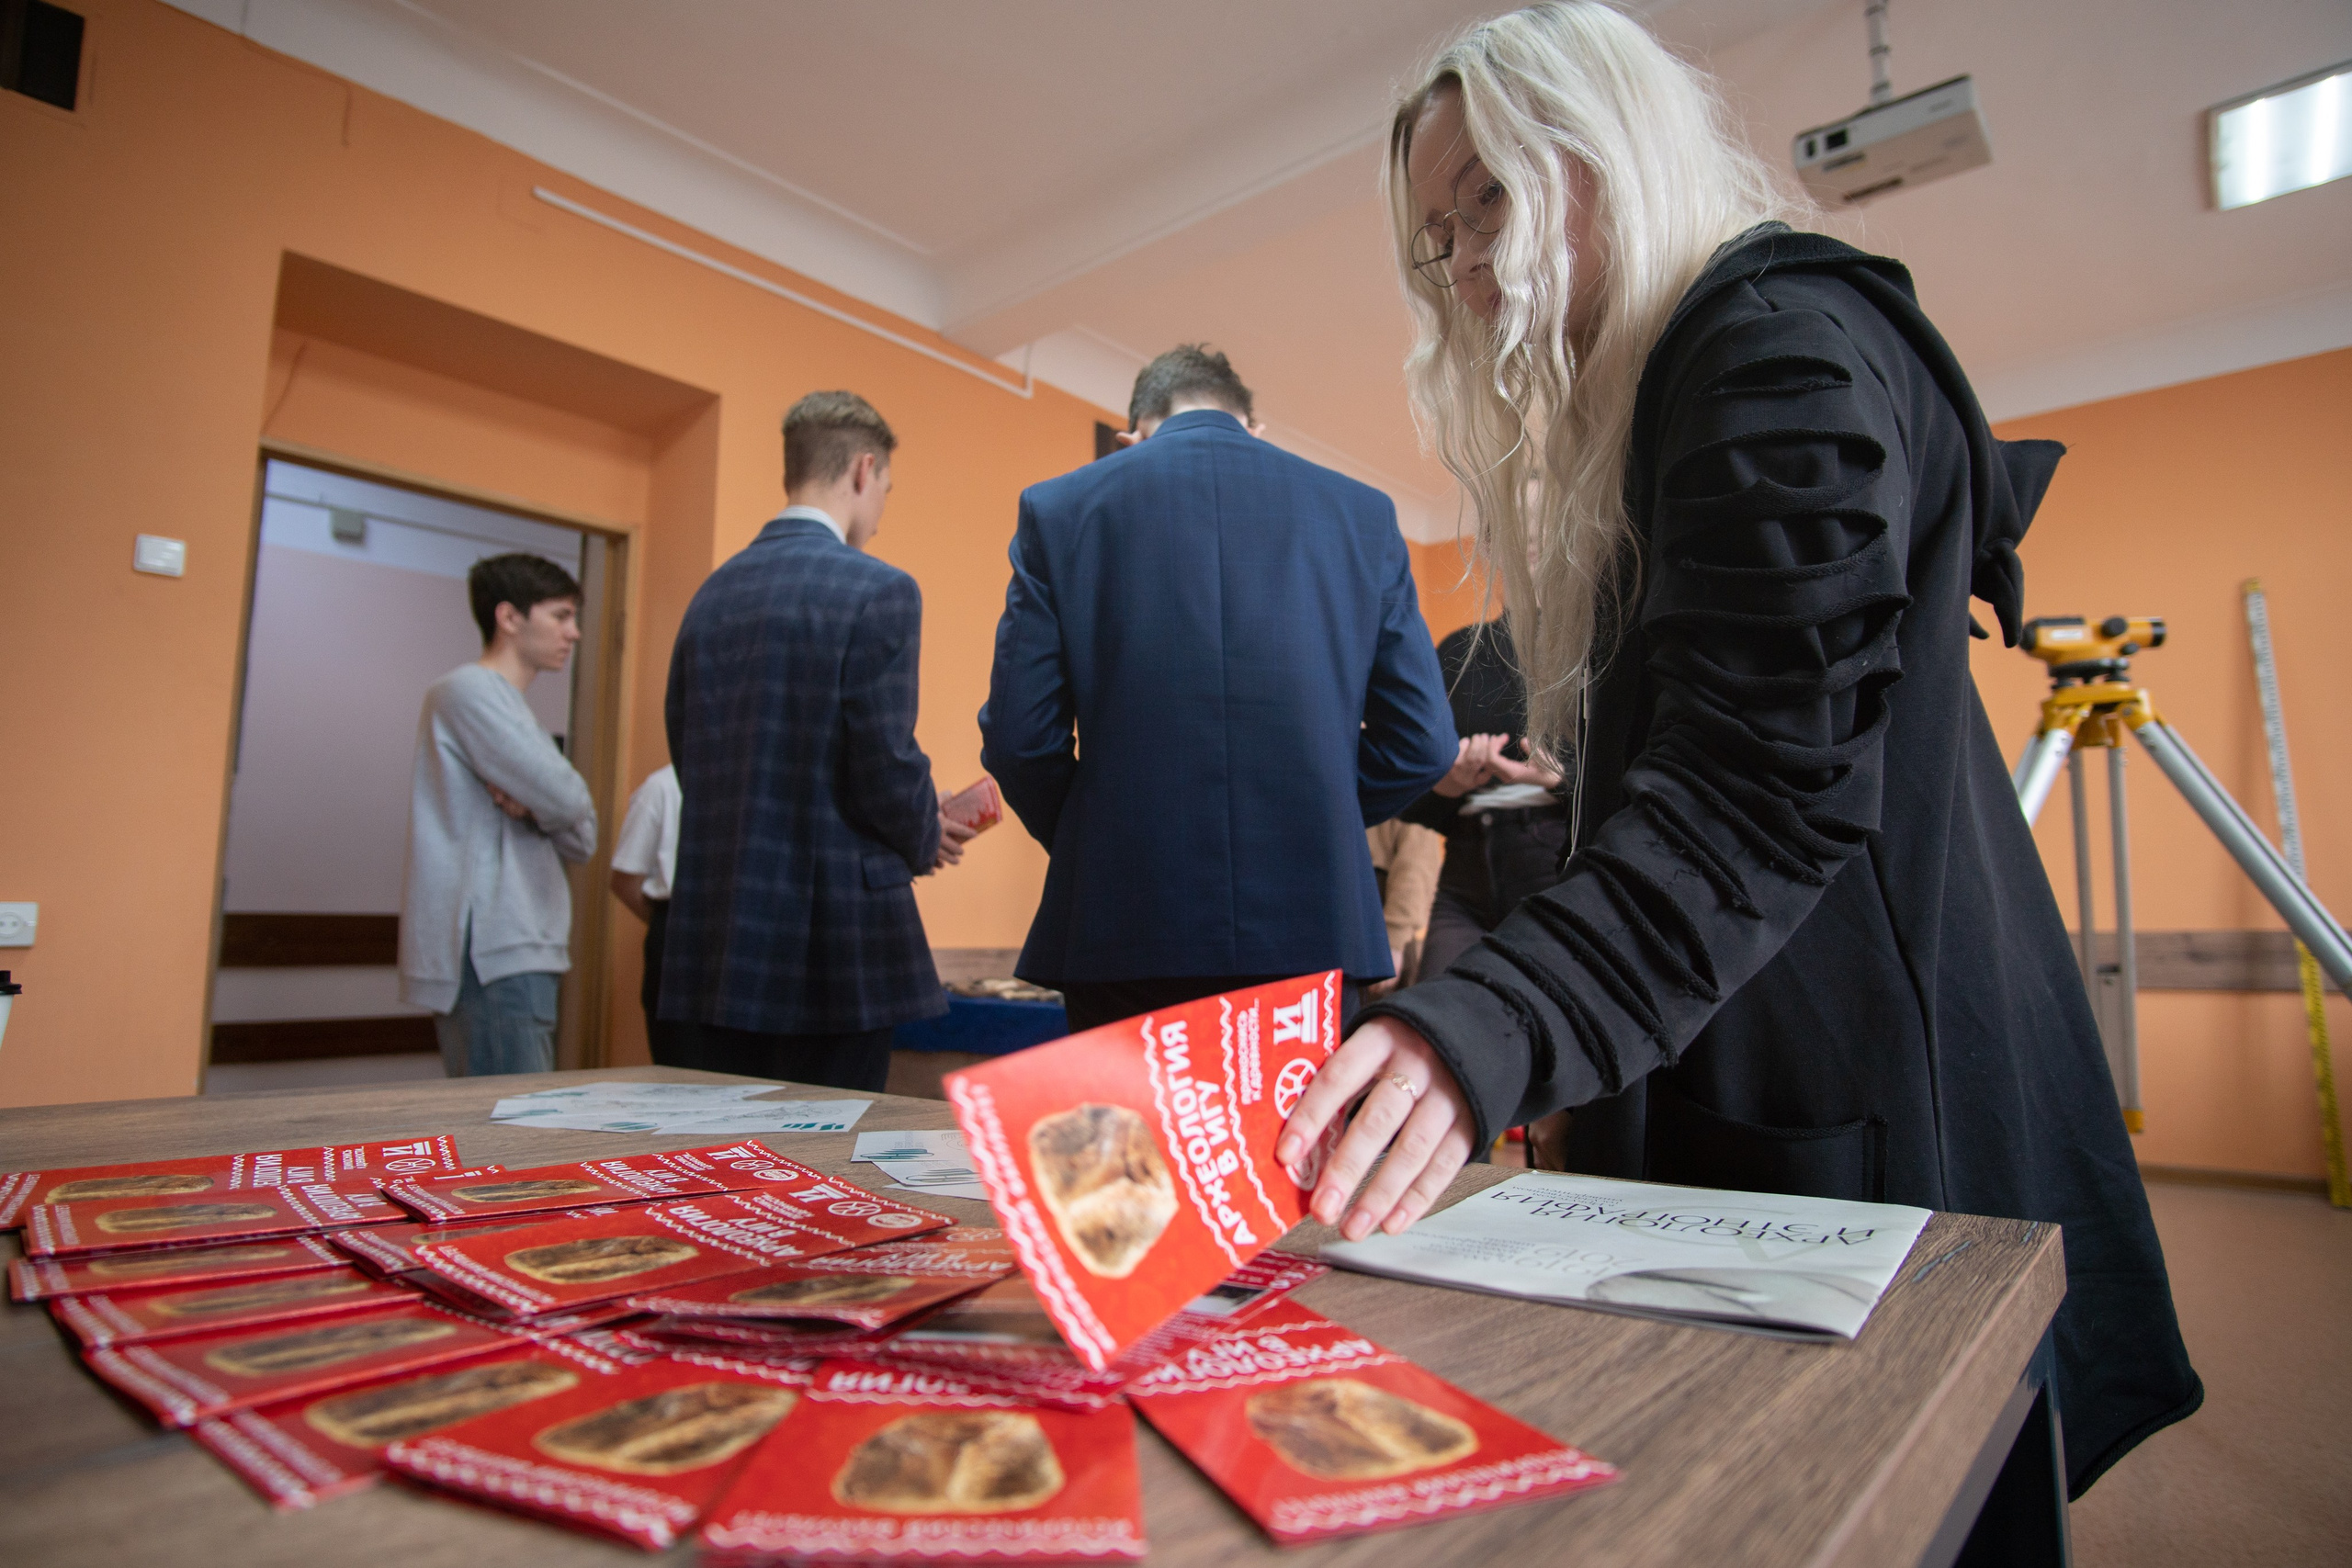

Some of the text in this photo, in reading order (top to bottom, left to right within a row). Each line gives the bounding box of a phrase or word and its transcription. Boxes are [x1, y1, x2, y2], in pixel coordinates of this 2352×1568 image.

[1160, 1021, 1258, 1246] АРХЕОЛОГИЯ
[1195, 1080, 1239, 1176] В ИГУ
[254, 1154, 282, 1187] ЕОЛОГИЯ
[287, 1167, 315, 1179] ИГУ
[599, 1160, 683, 1193] АРХЕОЛОГИЯ
[642, 1168, 680, 1179] ИГУ
[301, 1184, 365, 1220] АРХЕОЛОГИЯ
[1490, 1191, 1875, 1237] И ЭТНОГРАФИЯ
[668, 1204, 805, 1257] АРХЕОЛОГИЯ
[727, 1217, 797, 1238] В ИГУ
[1529, 1207, 1871, 1246] АРХЕОЛОГИЯ
